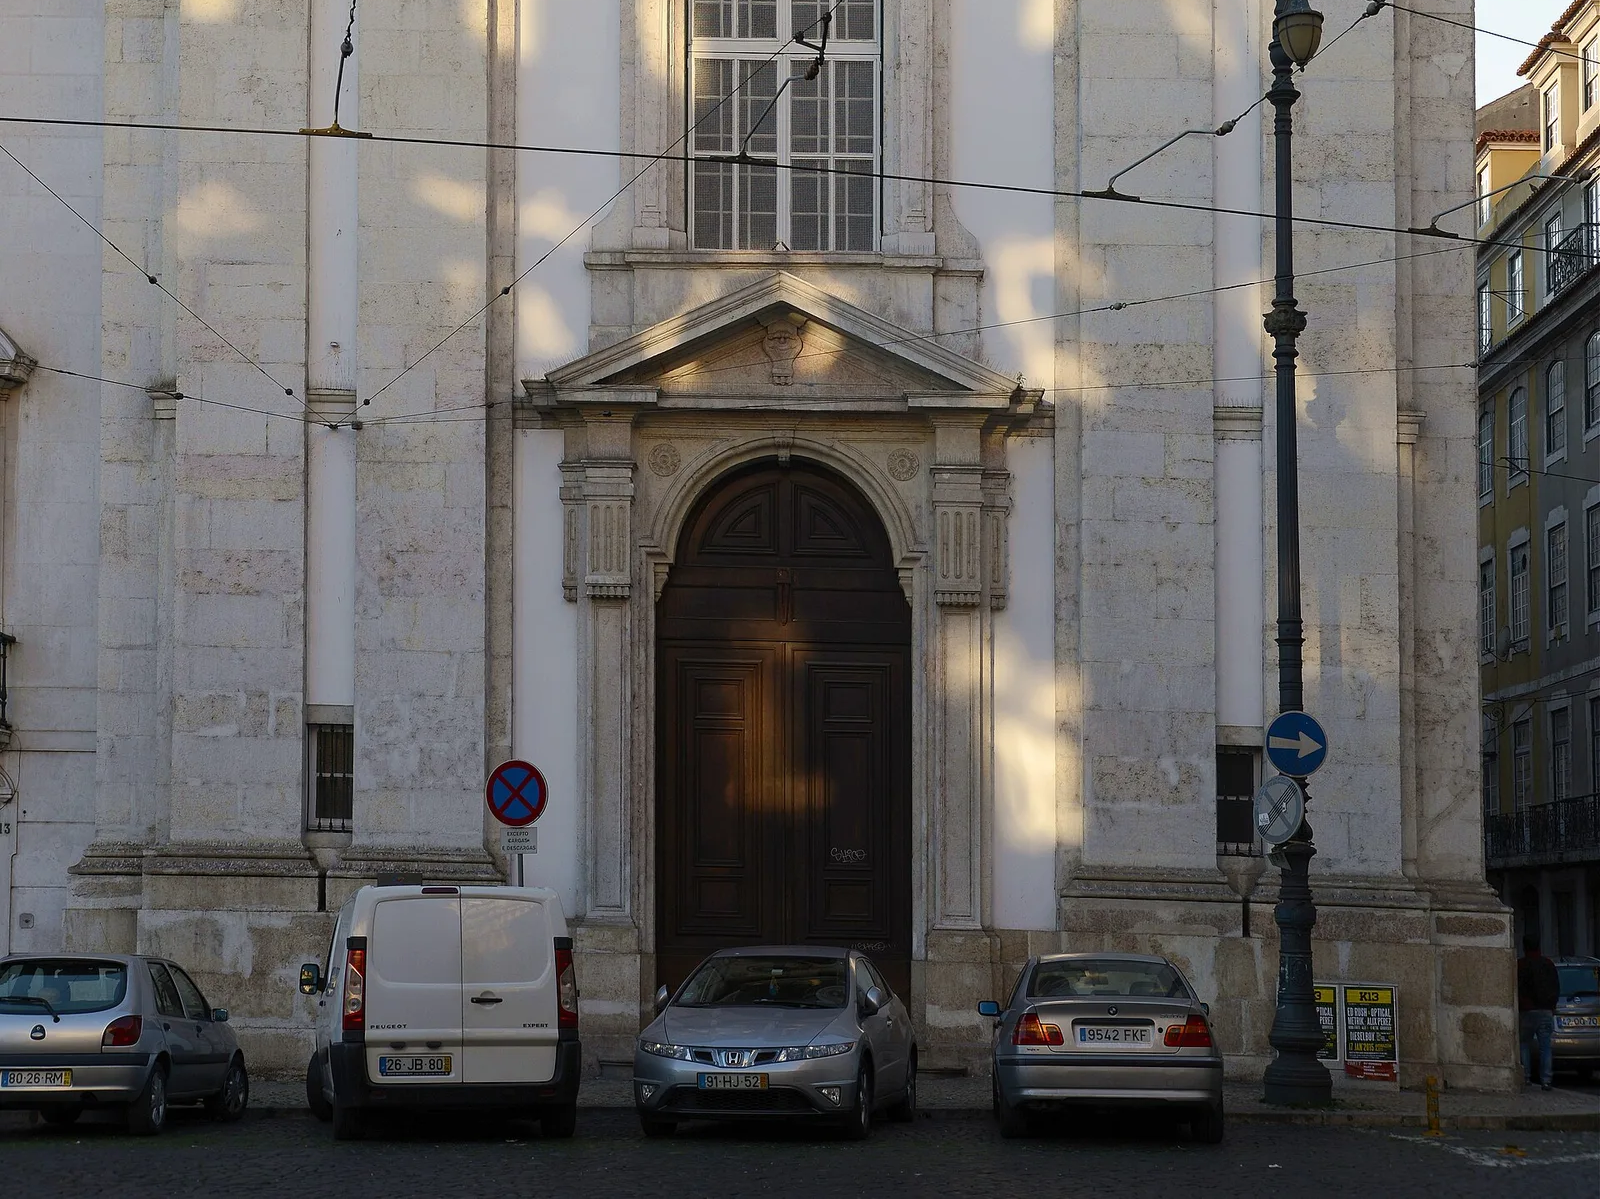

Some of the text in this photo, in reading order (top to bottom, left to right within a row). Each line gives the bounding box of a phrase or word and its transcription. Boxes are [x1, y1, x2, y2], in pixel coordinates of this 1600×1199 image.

[1359, 992, 1379, 1002] K13
[1371, 1008, 1391, 1017] OPTICAL
[1088, 1029, 1148, 1041] 9542 FKF
